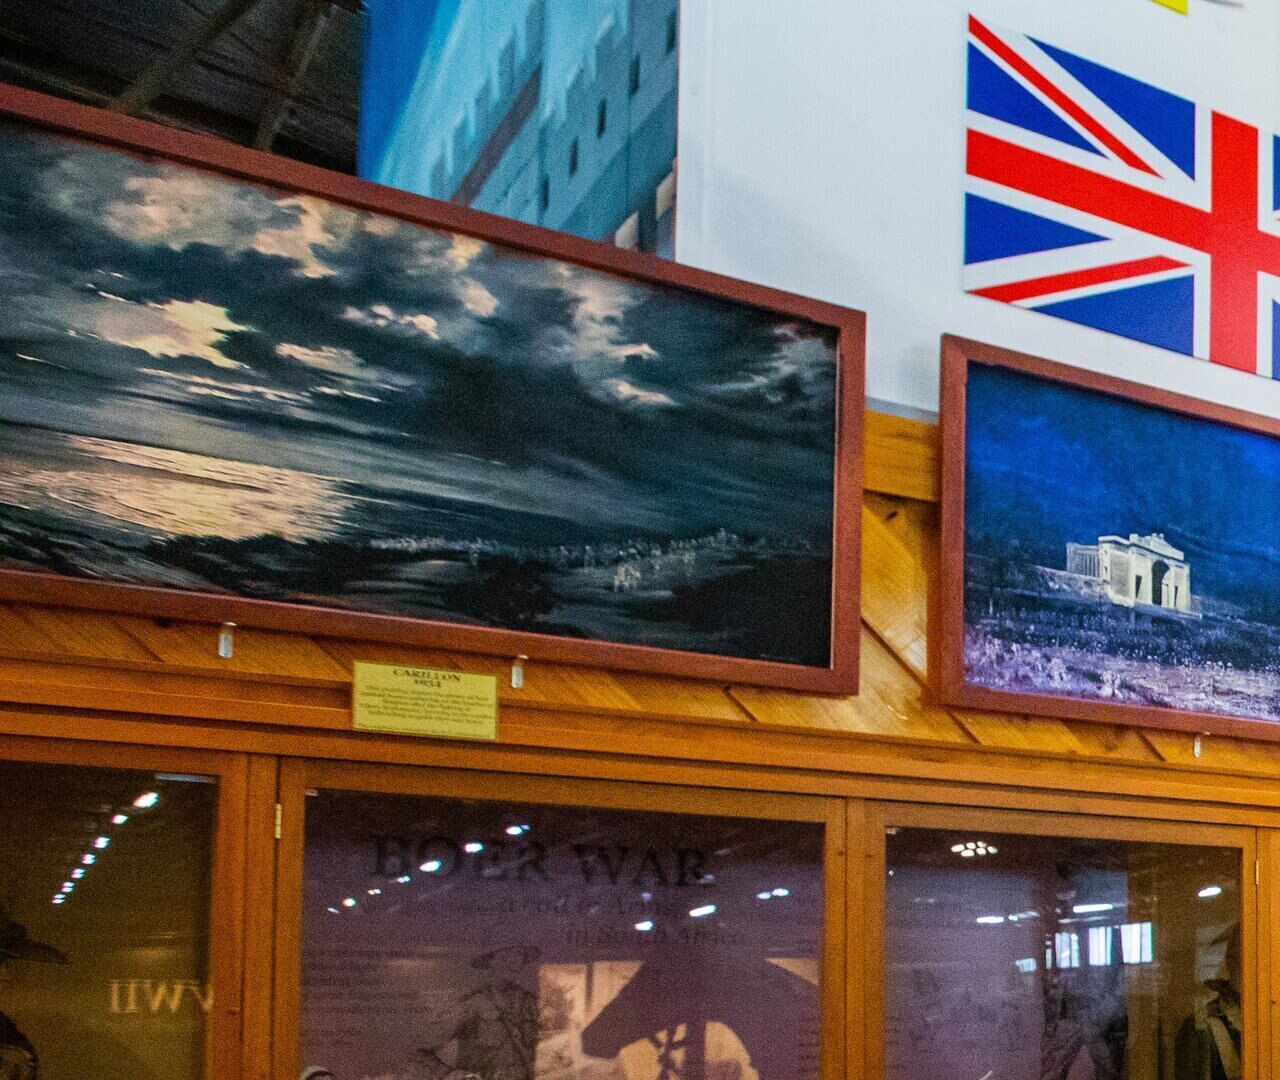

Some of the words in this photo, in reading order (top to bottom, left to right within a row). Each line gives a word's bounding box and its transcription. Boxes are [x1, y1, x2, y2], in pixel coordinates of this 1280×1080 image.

[392, 668, 462, 682] CARILLON
[369, 833, 551, 885] BOER
[572, 842, 713, 888] WAR
